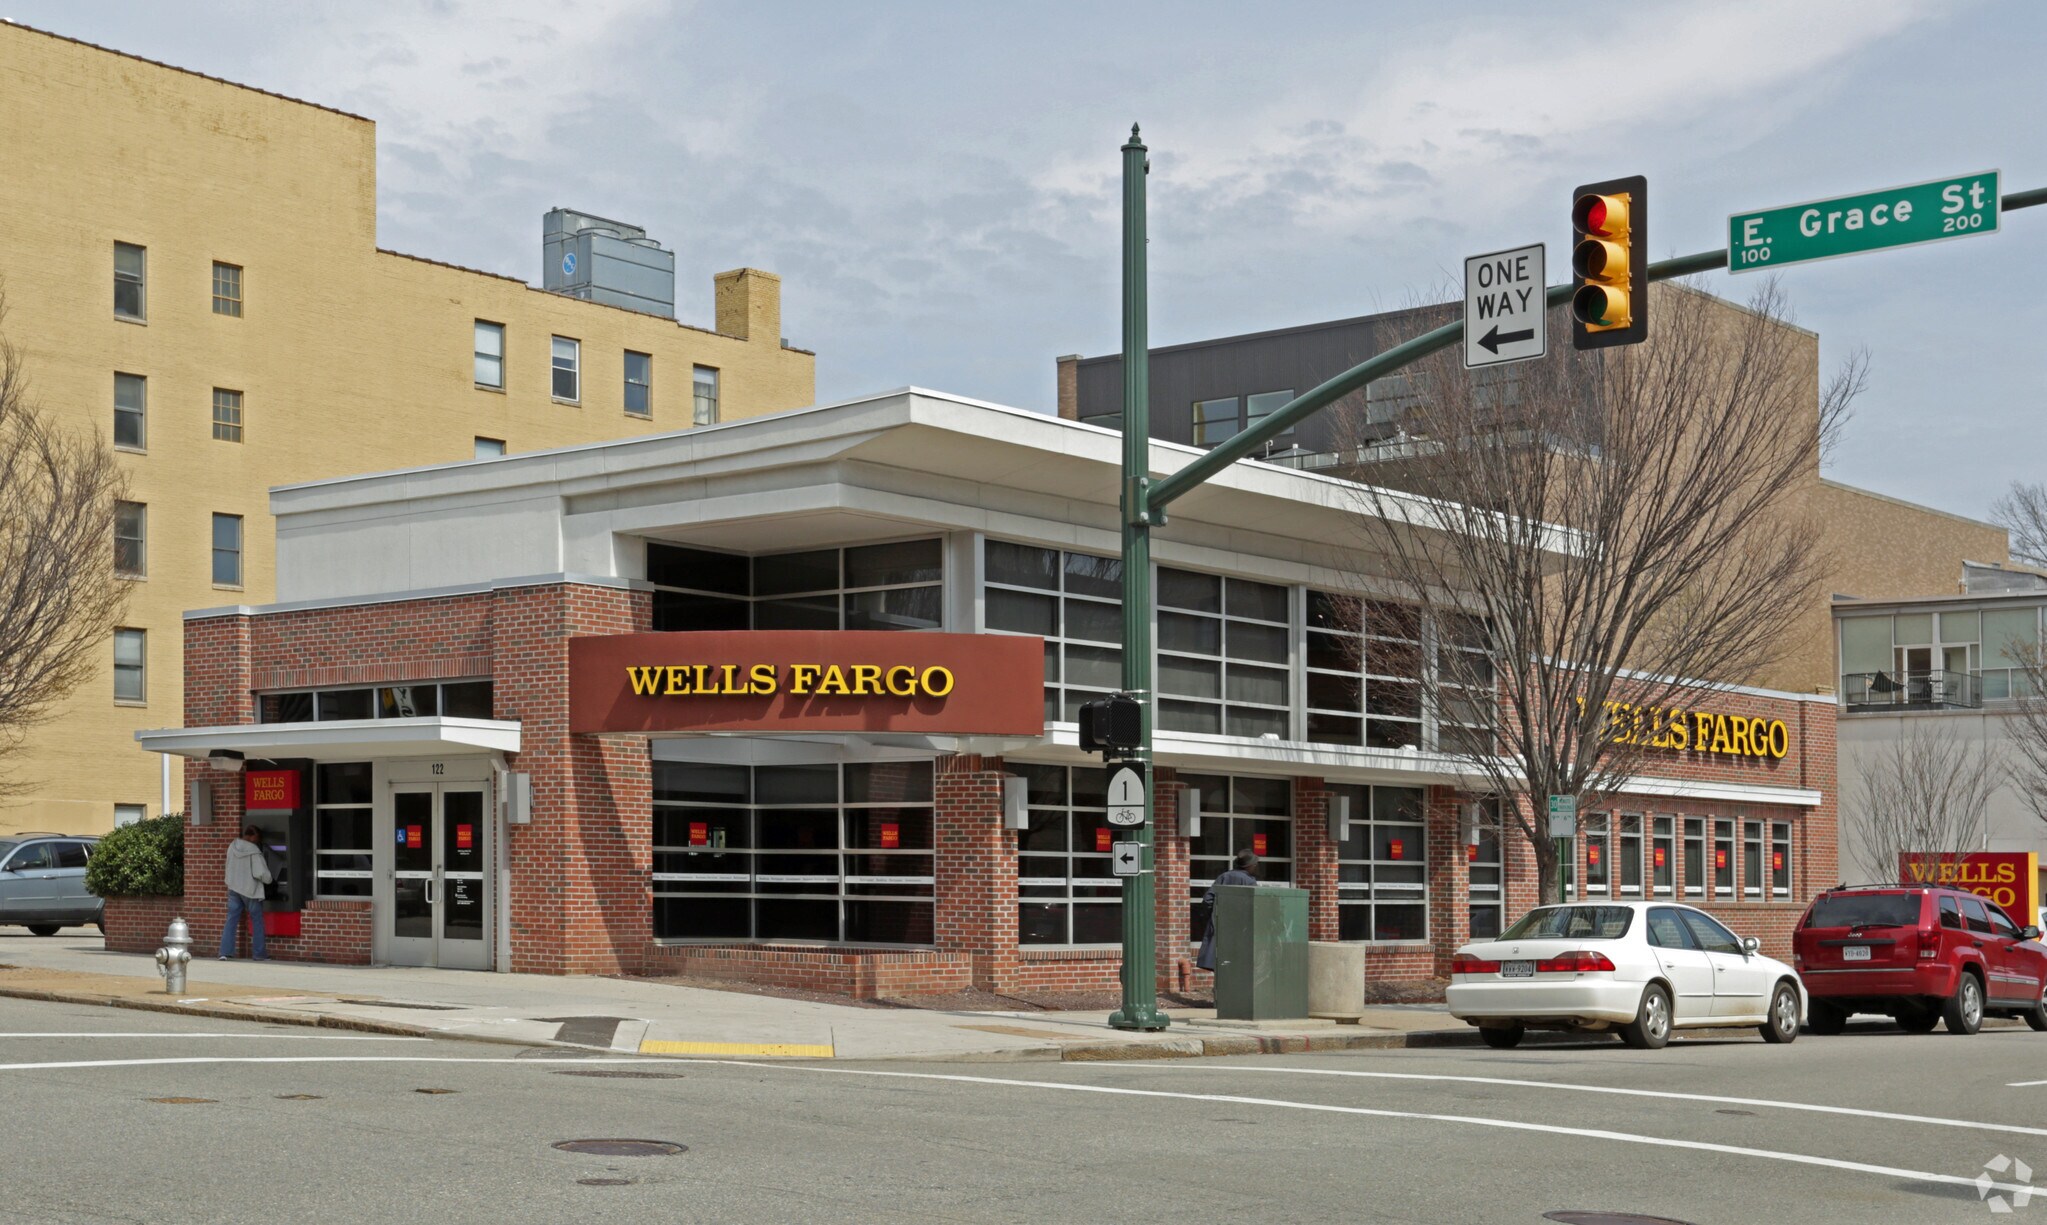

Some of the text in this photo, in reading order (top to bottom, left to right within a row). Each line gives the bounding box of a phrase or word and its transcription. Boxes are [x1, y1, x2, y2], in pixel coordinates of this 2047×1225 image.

[1744, 180, 1985, 247] E. Grace St
[1943, 213, 1982, 233] 200
[1741, 247, 1771, 264] 100
[1478, 255, 1530, 288] ONE
[1476, 286, 1533, 320] WAY
[626, 664, 955, 698] WELLS FARGO
[1694, 711, 1790, 759] FARGO
[431, 763, 444, 775] 122
[253, 777, 285, 788] WELLS
[1122, 780, 1128, 801] 1
[253, 789, 285, 801] FARGO
[1909, 862, 2016, 883] WELLS
